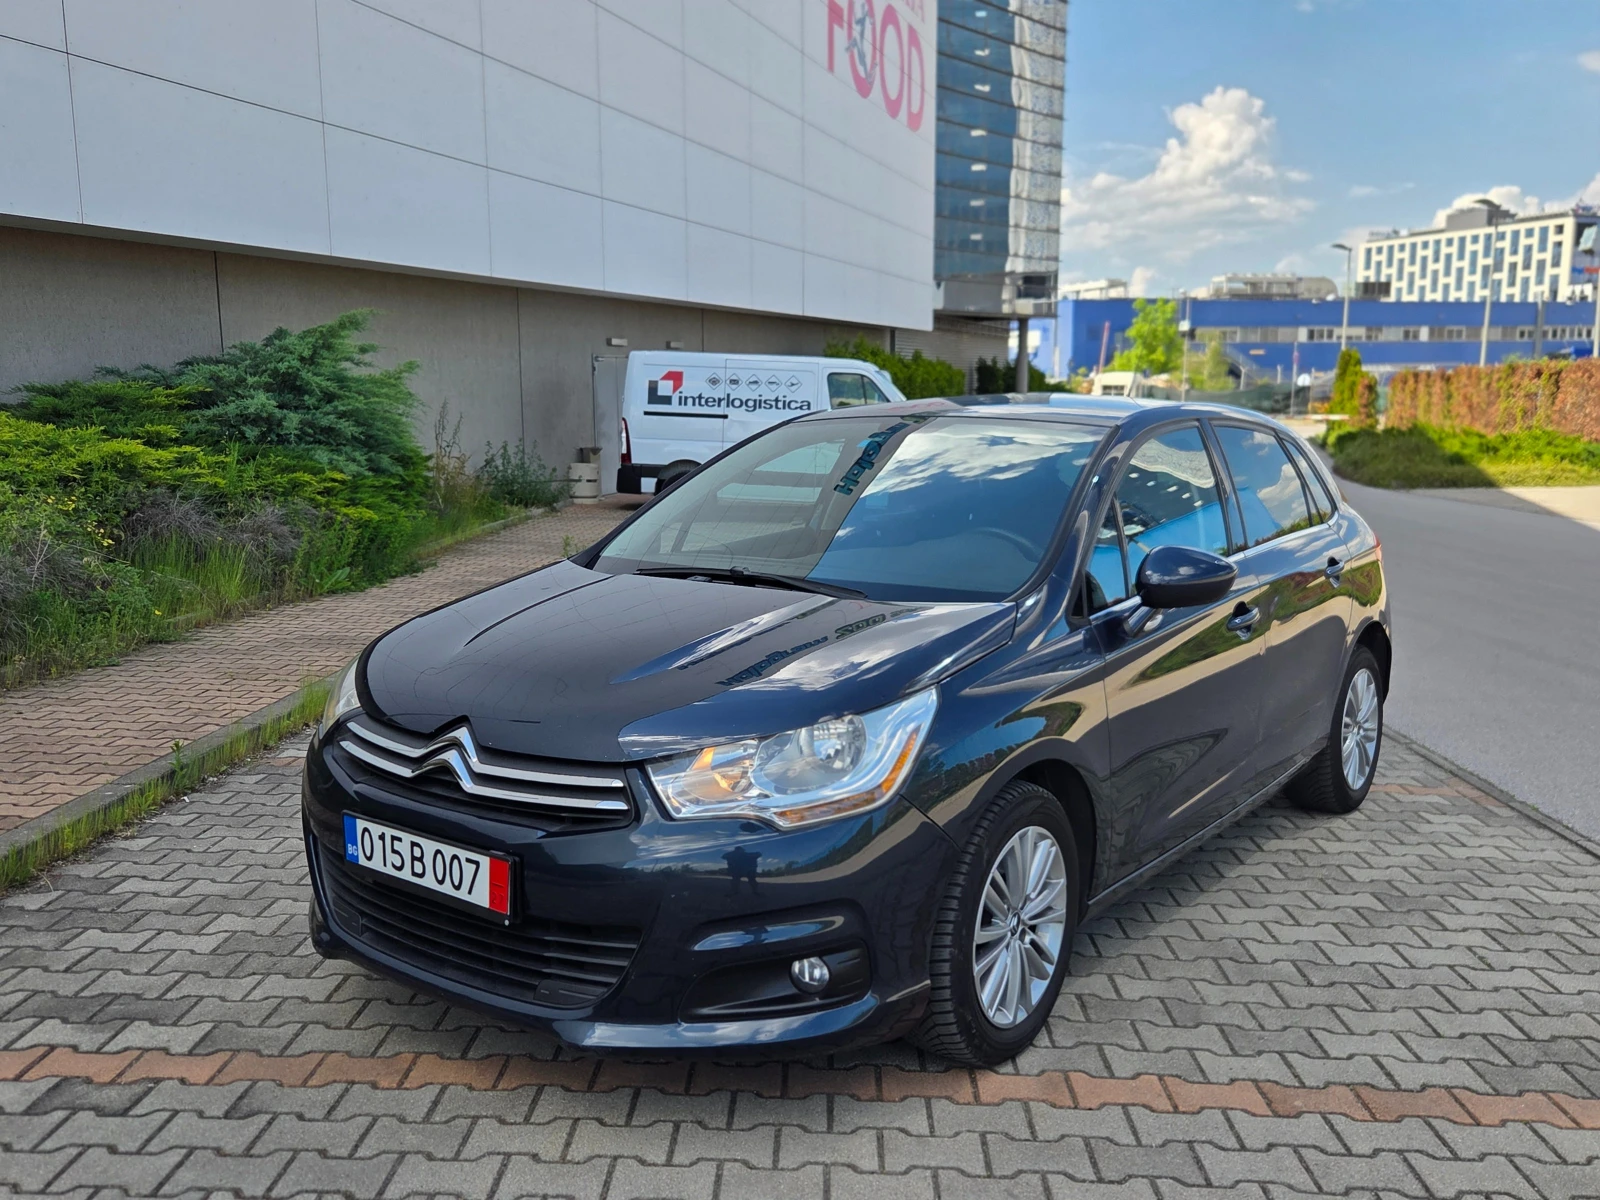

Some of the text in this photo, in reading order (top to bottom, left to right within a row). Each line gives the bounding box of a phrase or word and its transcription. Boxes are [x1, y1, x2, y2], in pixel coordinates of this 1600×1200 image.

[827, 0, 925, 132] FOOD
[678, 391, 811, 412] interlogistica
[347, 843, 358, 856] BG
